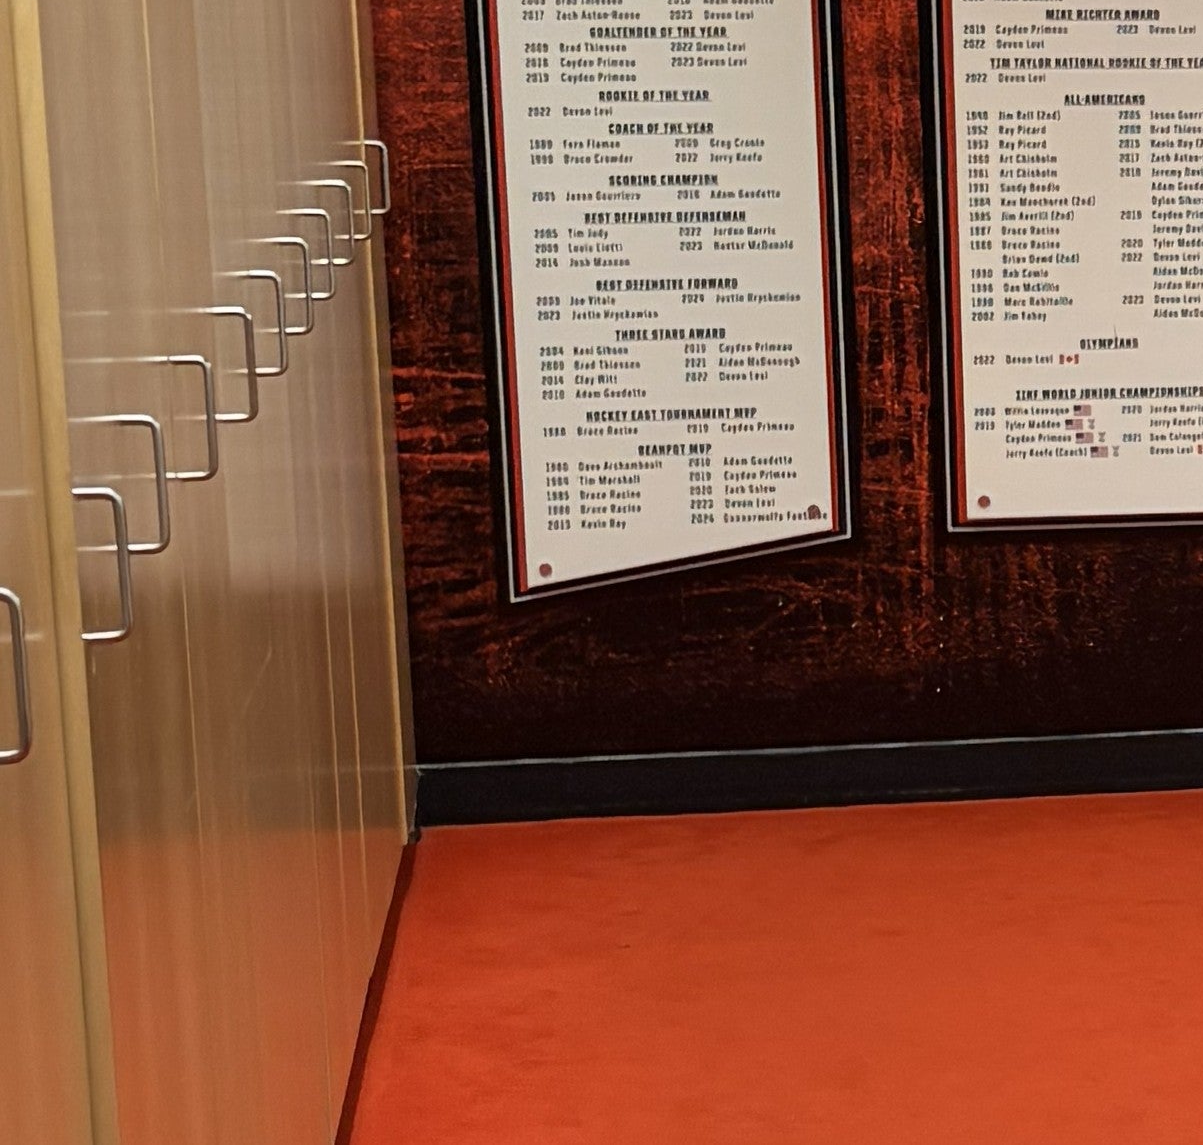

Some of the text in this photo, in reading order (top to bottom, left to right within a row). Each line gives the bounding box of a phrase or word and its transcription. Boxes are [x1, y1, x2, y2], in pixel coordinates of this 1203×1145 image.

[1045, 9, 1160, 20] MIKE RICHTER AWARD
[589, 26, 727, 38] GOALTENDER OF THE YEAR
[989, 57, 1011, 69] TIM
[1014, 57, 1052, 69] TAYLOR
[1054, 57, 1105, 69] NATIONAL
[1108, 57, 1146, 69] ROOKIE
[1149, 57, 1161, 69] OF
[1164, 57, 1184, 69] THE
[598, 89, 709, 102] ROOKIE OF THE YEAR
[608, 122, 714, 135] COACH OF THE YEAR
[608, 174, 718, 186] SCORING CHAMPION
[615, 327, 726, 341] THREE STARS AWARD
[585, 407, 757, 422] HOCKEY EAST TOURNAMENT MVP
[637, 443, 712, 456] BEANPOT MVP
